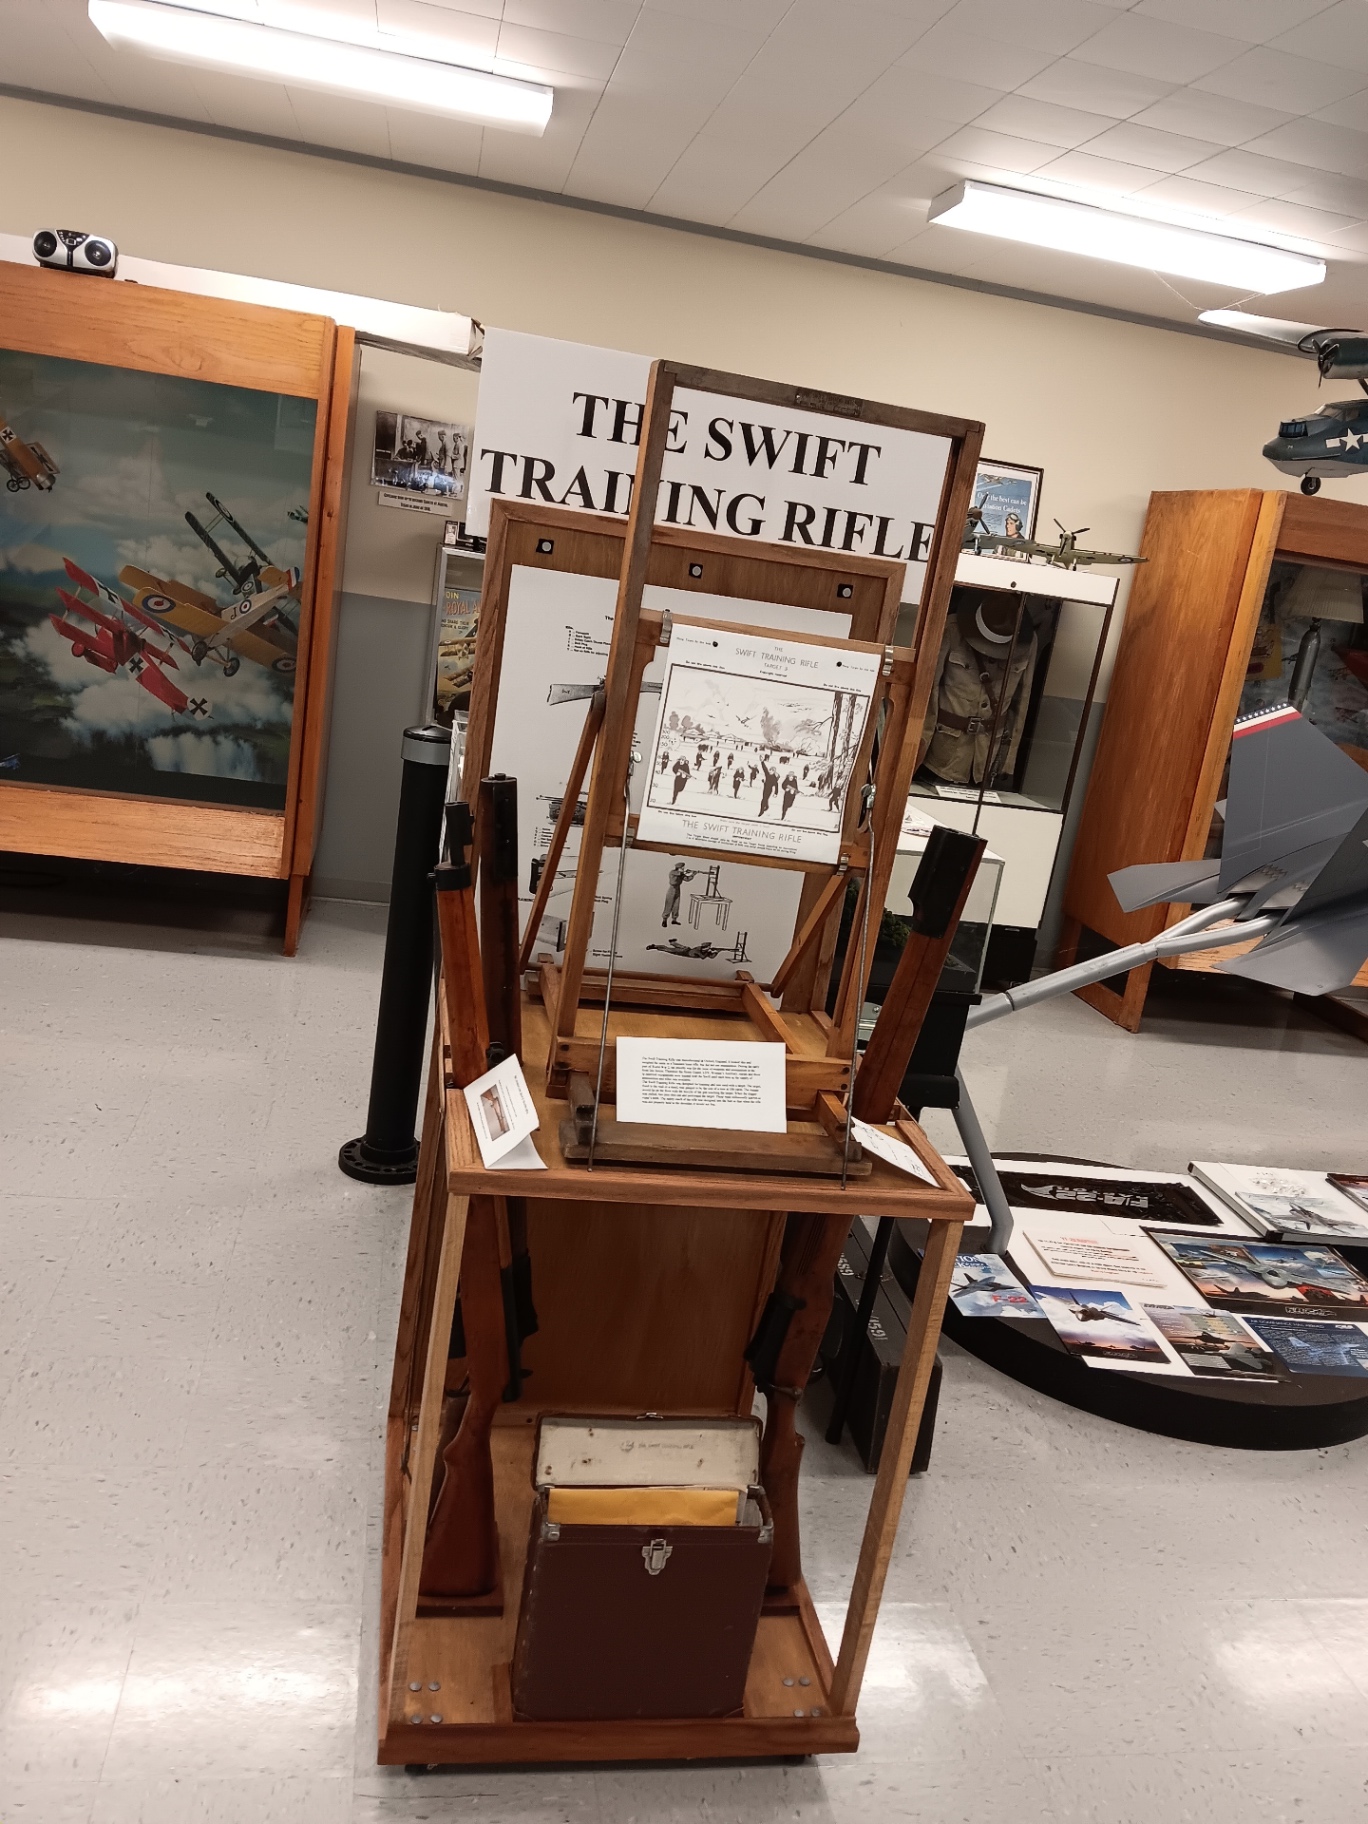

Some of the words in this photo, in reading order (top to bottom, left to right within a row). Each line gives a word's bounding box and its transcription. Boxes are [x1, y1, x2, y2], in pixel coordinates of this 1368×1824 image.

[572, 391, 689, 454] THE
[703, 416, 882, 486] SWIFT
[480, 447, 768, 537] TRAIING
[778, 499, 936, 563] RIFLE
[735, 647, 757, 658] SWIFT
[761, 652, 796, 665] TRAINING
[800, 659, 819, 669] RIFLE
[682, 819, 699, 830] THE
[703, 822, 729, 833] SWIFT
[732, 827, 776, 840] TRAINING
[778, 833, 802, 844] RIFLE
